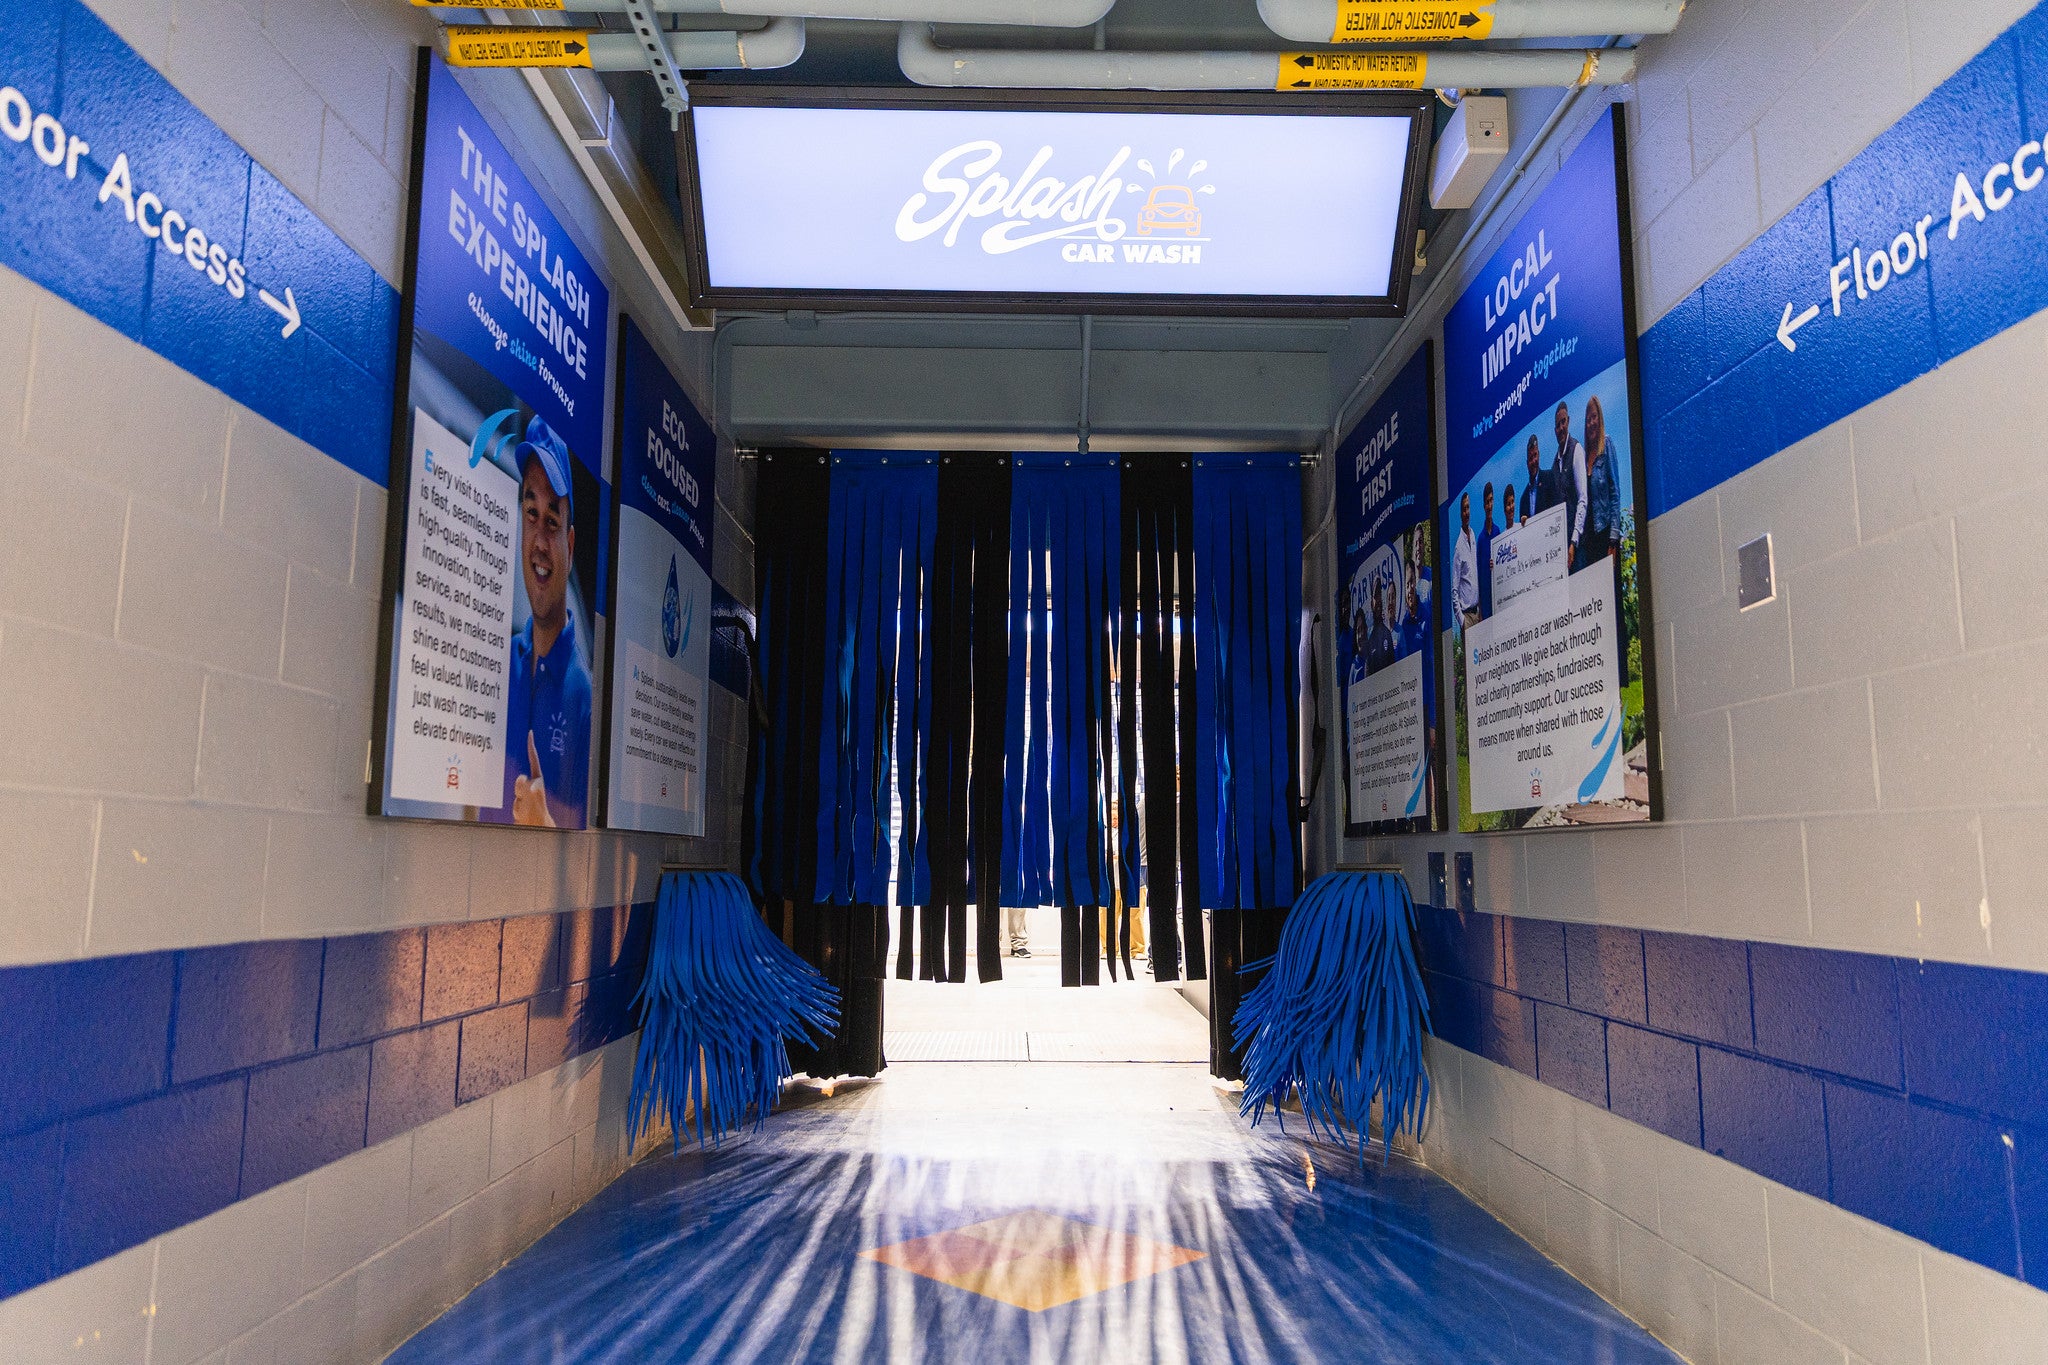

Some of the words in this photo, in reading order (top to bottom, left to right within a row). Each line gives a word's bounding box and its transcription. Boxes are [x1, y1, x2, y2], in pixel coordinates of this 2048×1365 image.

[526, 0, 560, 8] WATER
[1346, 13, 1380, 31] WATER
[1381, 12, 1402, 30] HOT
[1405, 12, 1458, 30] DOMESTIC
[490, 42, 511, 60] WATER
[512, 41, 526, 58] HOT
[527, 40, 562, 58] DOMESTIC
[1316, 54, 1351, 70] DOMESTIC
[1352, 55, 1366, 70] HOT
[1367, 56, 1389, 71] WATER
[1390, 56, 1418, 72] RETURN
[895, 140, 1131, 254] Splash
[99, 152, 246, 299] Access
[458, 125, 507, 225] THE
[512, 201, 590, 329] SPLASH
[1829, 214, 1932, 317] Floor
[1947, 131, 2048, 240] Acc
[1061, 243, 1115, 263] CAR
[1122, 244, 1202, 264] WASH
[448, 187, 586, 381] EXPERIENCE
[1484, 228, 1552, 332] LOCAL
[467, 291, 508, 351] always
[509, 338, 537, 371] shine
[538, 357, 575, 417] forward
[1482, 272, 1560, 389] IMPACT
[1472, 414, 1494, 439] we're
[1494, 370, 1532, 424] stronger
[1533, 336, 1578, 380] together
[662, 400, 690, 451] ECO-
[1356, 411, 1398, 483] PEOPLE
[424, 448, 452, 489] Every
[454, 476, 472, 500] visit
[474, 488, 482, 503] to
[484, 493, 509, 524] Splash
[647, 427, 699, 509] FOCUSED
[1362, 459, 1394, 516] FIRST
[420, 478, 429, 500] is
[430, 486, 450, 516] fast,
[452, 502, 492, 540] seamless,
[494, 525, 509, 549] and
[418, 507, 474, 556] high-quality.
[476, 541, 508, 574] Through
[422, 538, 472, 581] innovation,
[473, 568, 502, 598] top-tier
[416, 571, 452, 601] service,
[454, 588, 471, 608] and
[472, 596, 505, 622] superior
[412, 598, 447, 628] results,
[450, 616, 463, 632] we
[464, 622, 487, 642] make
[488, 634, 505, 650] cars
[1474, 642, 1494, 667] Splash
[1494, 641, 1500, 656] is
[1500, 639, 1517, 654] more
[1518, 630, 1533, 648] than
[1534, 628, 1538, 640] a
[1540, 622, 1552, 637] car
[412, 626, 440, 652] shine
[441, 638, 458, 658] and
[460, 650, 502, 674] customers
[1474, 673, 1488, 689] your
[1488, 658, 1520, 683] neighbors.
[1521, 650, 1532, 668] We
[1534, 645, 1549, 668] give
[1550, 638, 1568, 657] back
[1569, 622, 1602, 649] through
[411, 654, 430, 677] feel
[432, 663, 463, 689] valued.
[466, 672, 479, 693] We
[480, 680, 500, 700] don't
[412, 685, 432, 708] just
[433, 694, 458, 714] wash
[1475, 691, 1488, 707] local
[1490, 683, 1510, 706] charity
[1511, 667, 1556, 698] partnerships,
[1557, 652, 1604, 680] fundraisers,
[1476, 713, 1488, 728] and
[1488, 702, 1523, 726] community
[1524, 692, 1554, 716] support.
[1554, 688, 1569, 706] Our
[1570, 678, 1604, 700] success
[1478, 734, 1498, 749] means
[1498, 730, 1515, 744] more
[1516, 724, 1534, 741] when
[1536, 714, 1560, 735] shared
[1561, 708, 1579, 728] with
[1580, 704, 1604, 724] those
[414, 717, 448, 740] elevate
[450, 728, 494, 752] driveways.
[1517, 743, 1541, 763] around
[1542, 743, 1554, 756] us.
